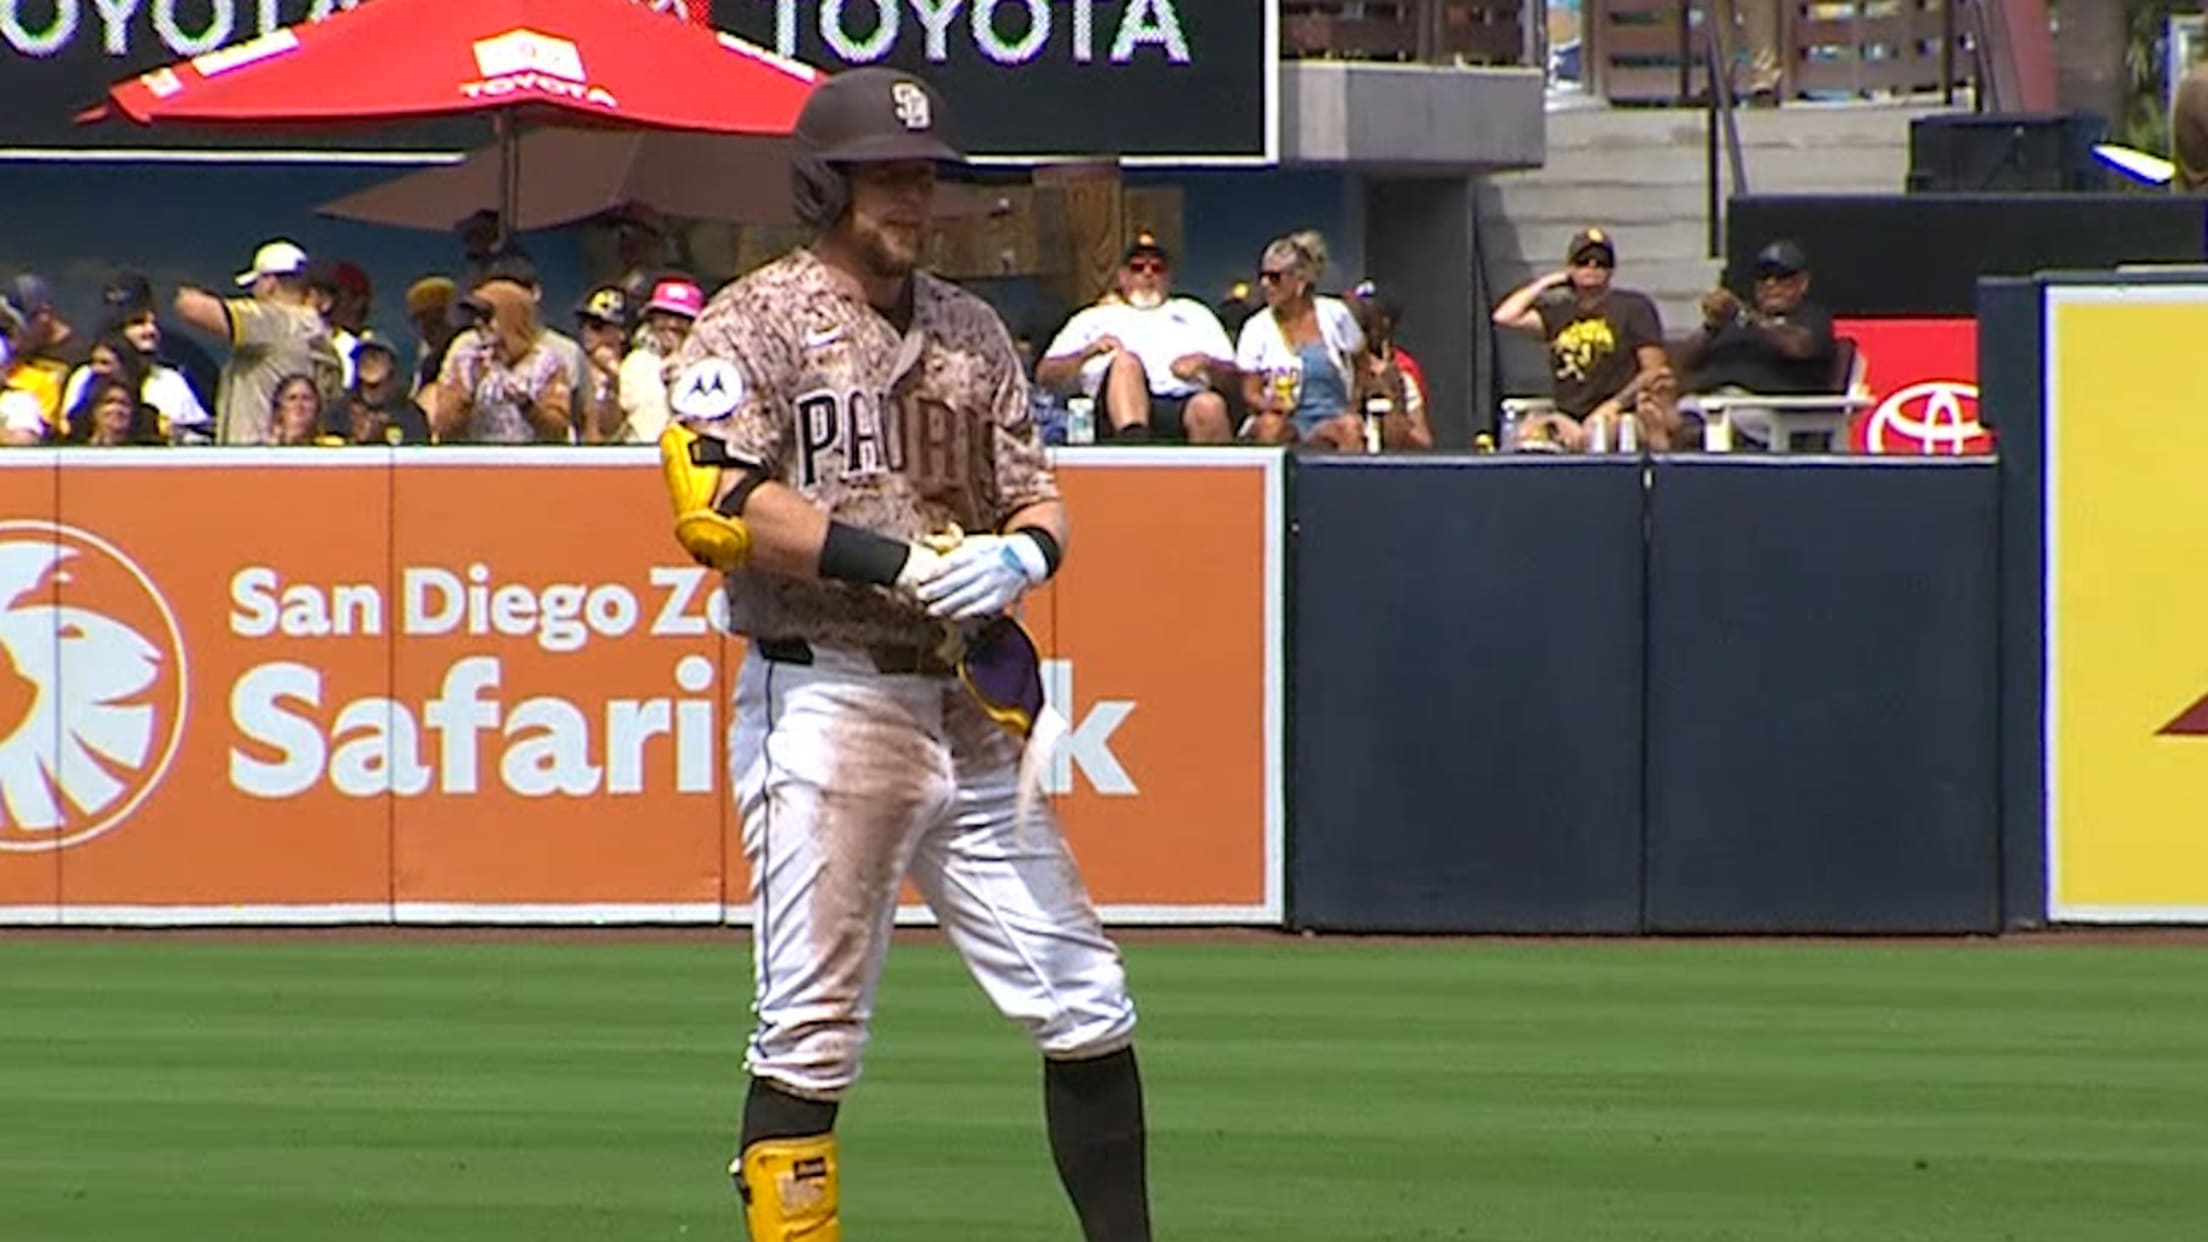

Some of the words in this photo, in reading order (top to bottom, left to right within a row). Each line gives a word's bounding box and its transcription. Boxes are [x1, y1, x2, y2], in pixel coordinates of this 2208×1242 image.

[229, 566, 381, 637] San
[403, 562, 638, 651] Diego
[229, 655, 714, 797] Safari
